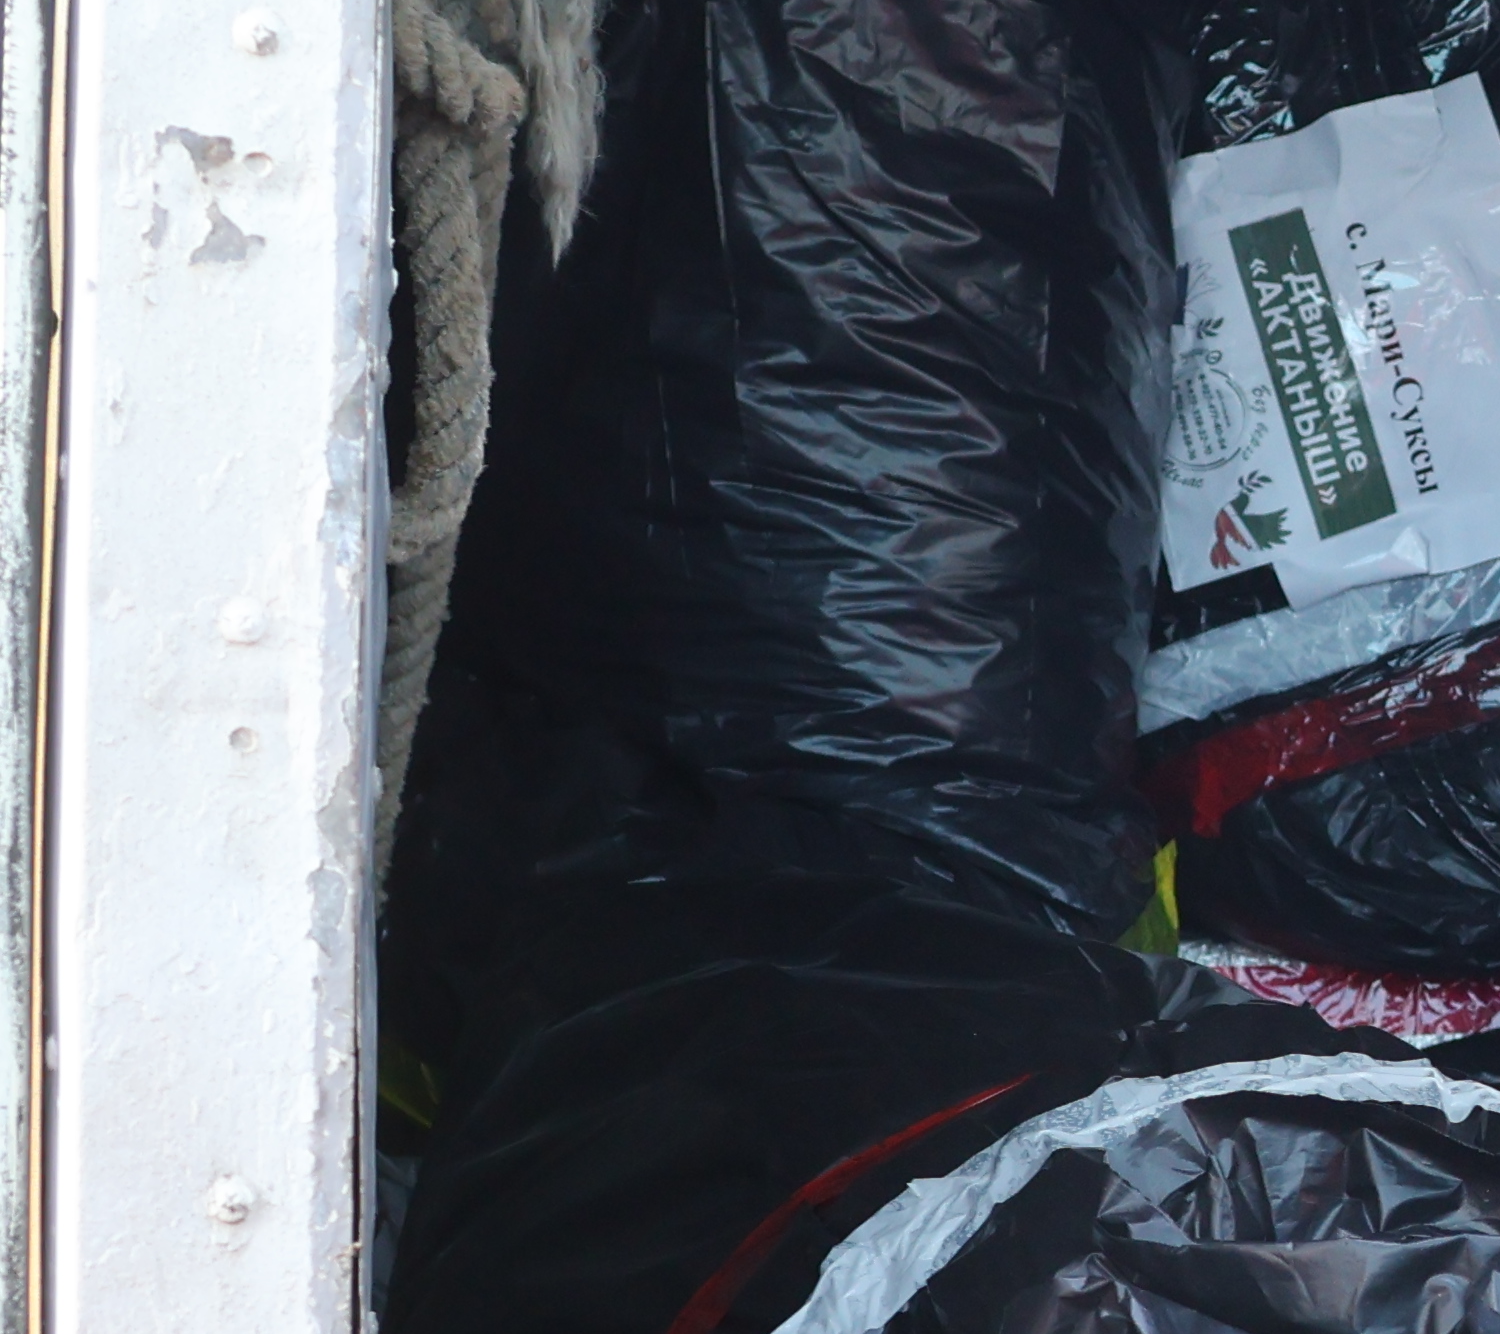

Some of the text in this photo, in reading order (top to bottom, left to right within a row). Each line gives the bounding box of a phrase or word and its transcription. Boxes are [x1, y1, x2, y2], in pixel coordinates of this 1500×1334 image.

[1249, 257, 1342, 506] «АКТАНЫШ»
[1281, 272, 1368, 474] Движение
[1345, 222, 1440, 496] с. Мари-Суксы
